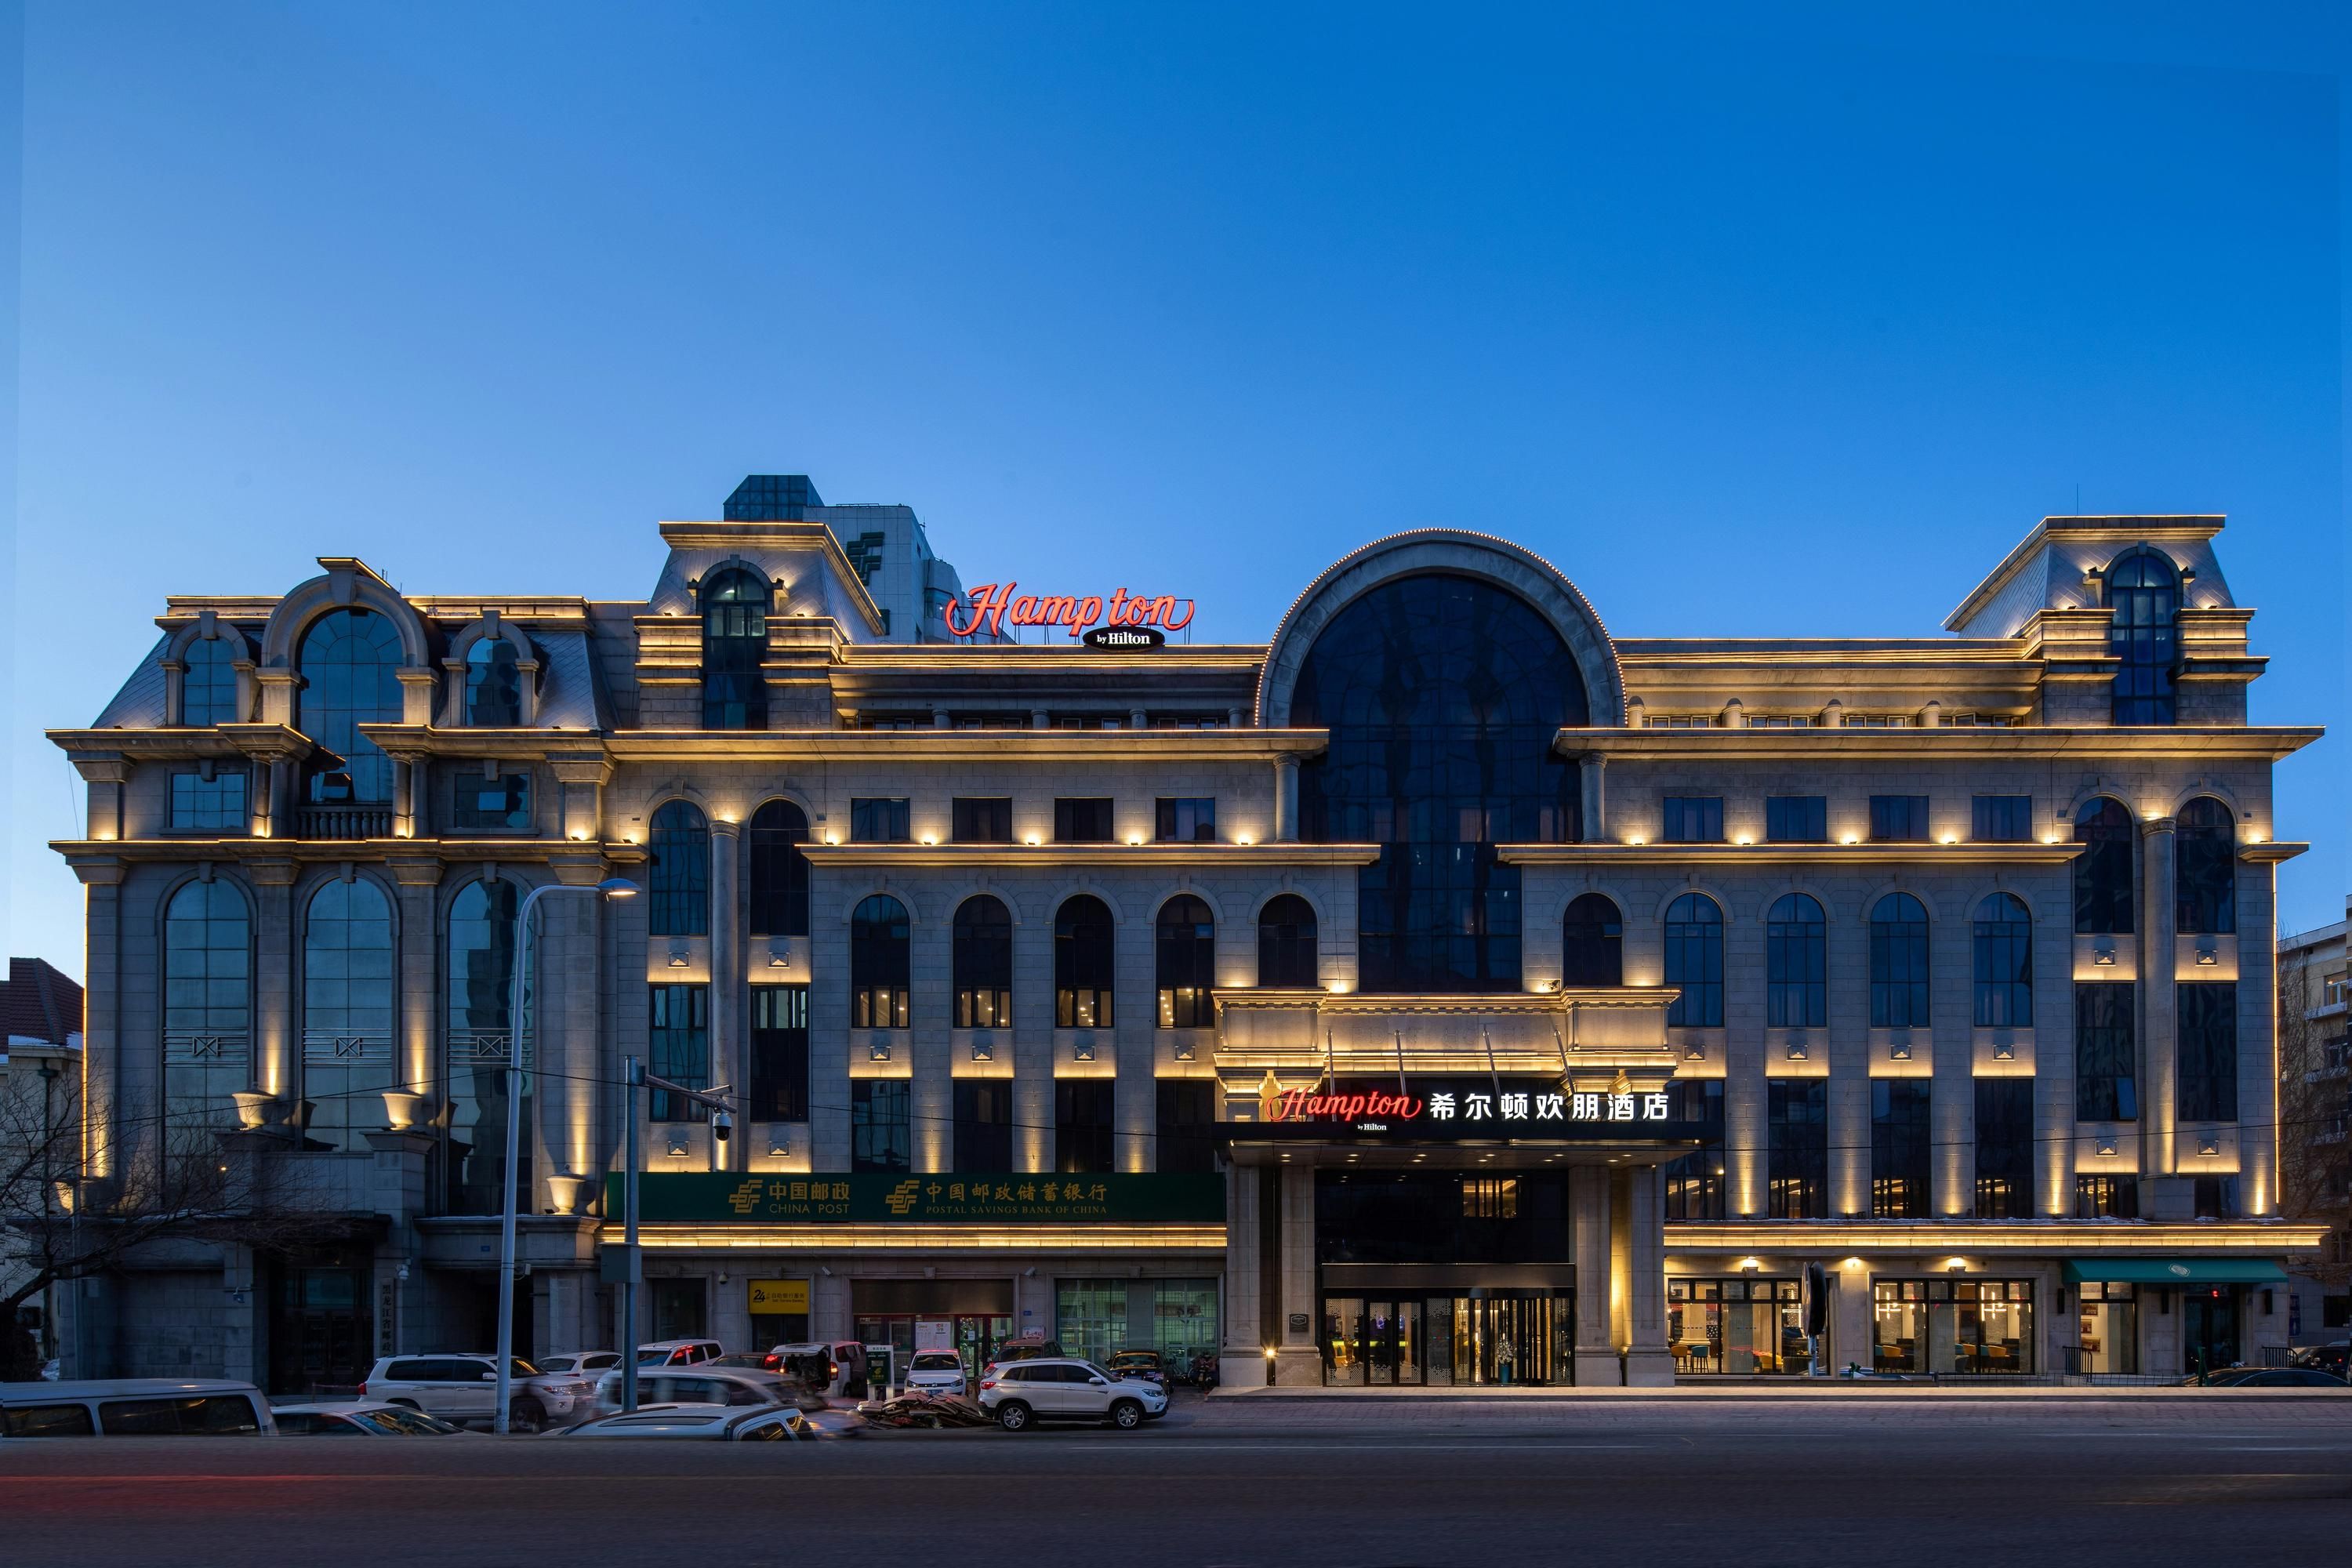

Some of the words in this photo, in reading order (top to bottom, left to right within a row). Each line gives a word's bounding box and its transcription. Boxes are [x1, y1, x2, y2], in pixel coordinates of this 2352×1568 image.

[945, 581, 1195, 637] Hampton
[1097, 634, 1106, 644] by
[1108, 633, 1150, 644] Hilton
[1265, 1086, 1422, 1122] Hampton
[1429, 1092, 1669, 1121] 希尔顿欢朋酒店
[769, 1181, 850, 1200] 中国邮政
[926, 1181, 1108, 1203] 中国邮政储蓄银行
[769, 1203, 811, 1214] CHINA
[818, 1203, 850, 1214] POST
[753, 1289, 765, 1302] 24
